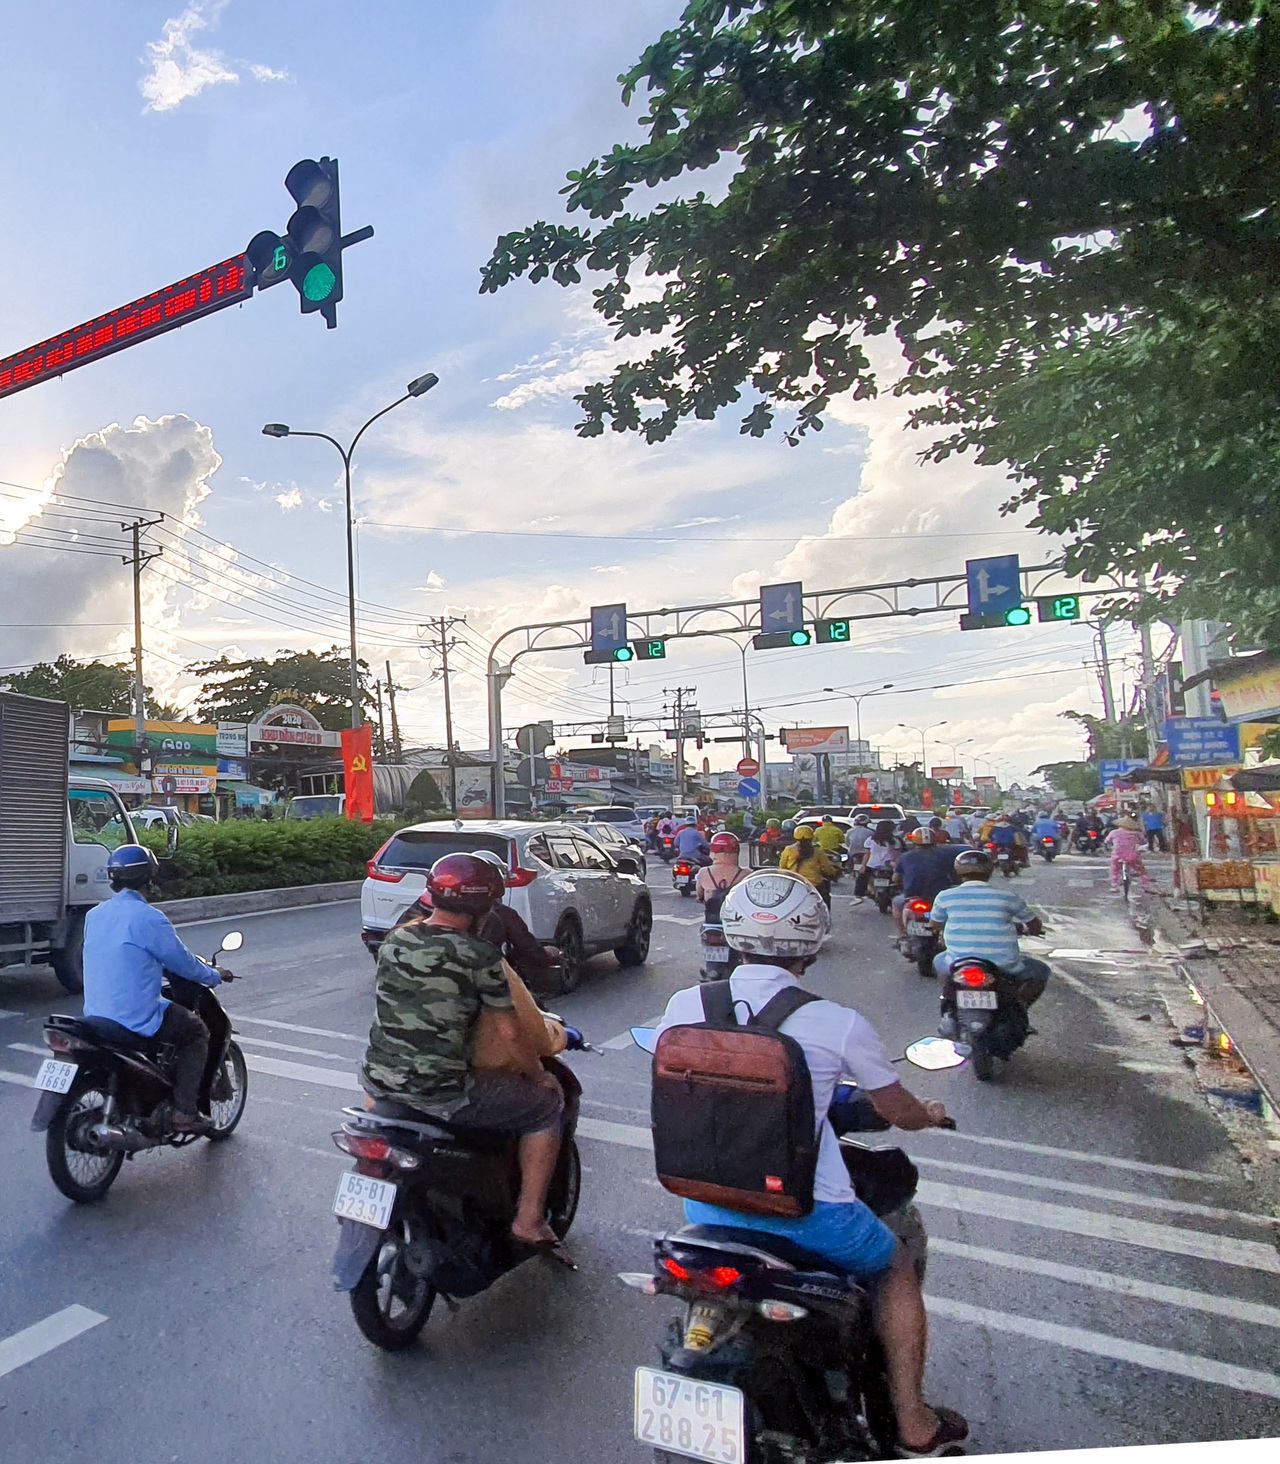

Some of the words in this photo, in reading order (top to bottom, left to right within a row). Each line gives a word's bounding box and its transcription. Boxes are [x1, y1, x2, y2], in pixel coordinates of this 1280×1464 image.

[274, 245, 286, 271] 6
[1053, 597, 1075, 618] 12
[829, 622, 847, 640] 12
[648, 641, 662, 656] 12
[44, 1061, 73, 1077] 95-F6
[40, 1075, 67, 1090] 1669
[347, 1176, 386, 1203] 65-B1
[336, 1194, 387, 1225] 523.91
[651, 1376, 725, 1422] 67-G1
[641, 1408, 738, 1462] 288.25
